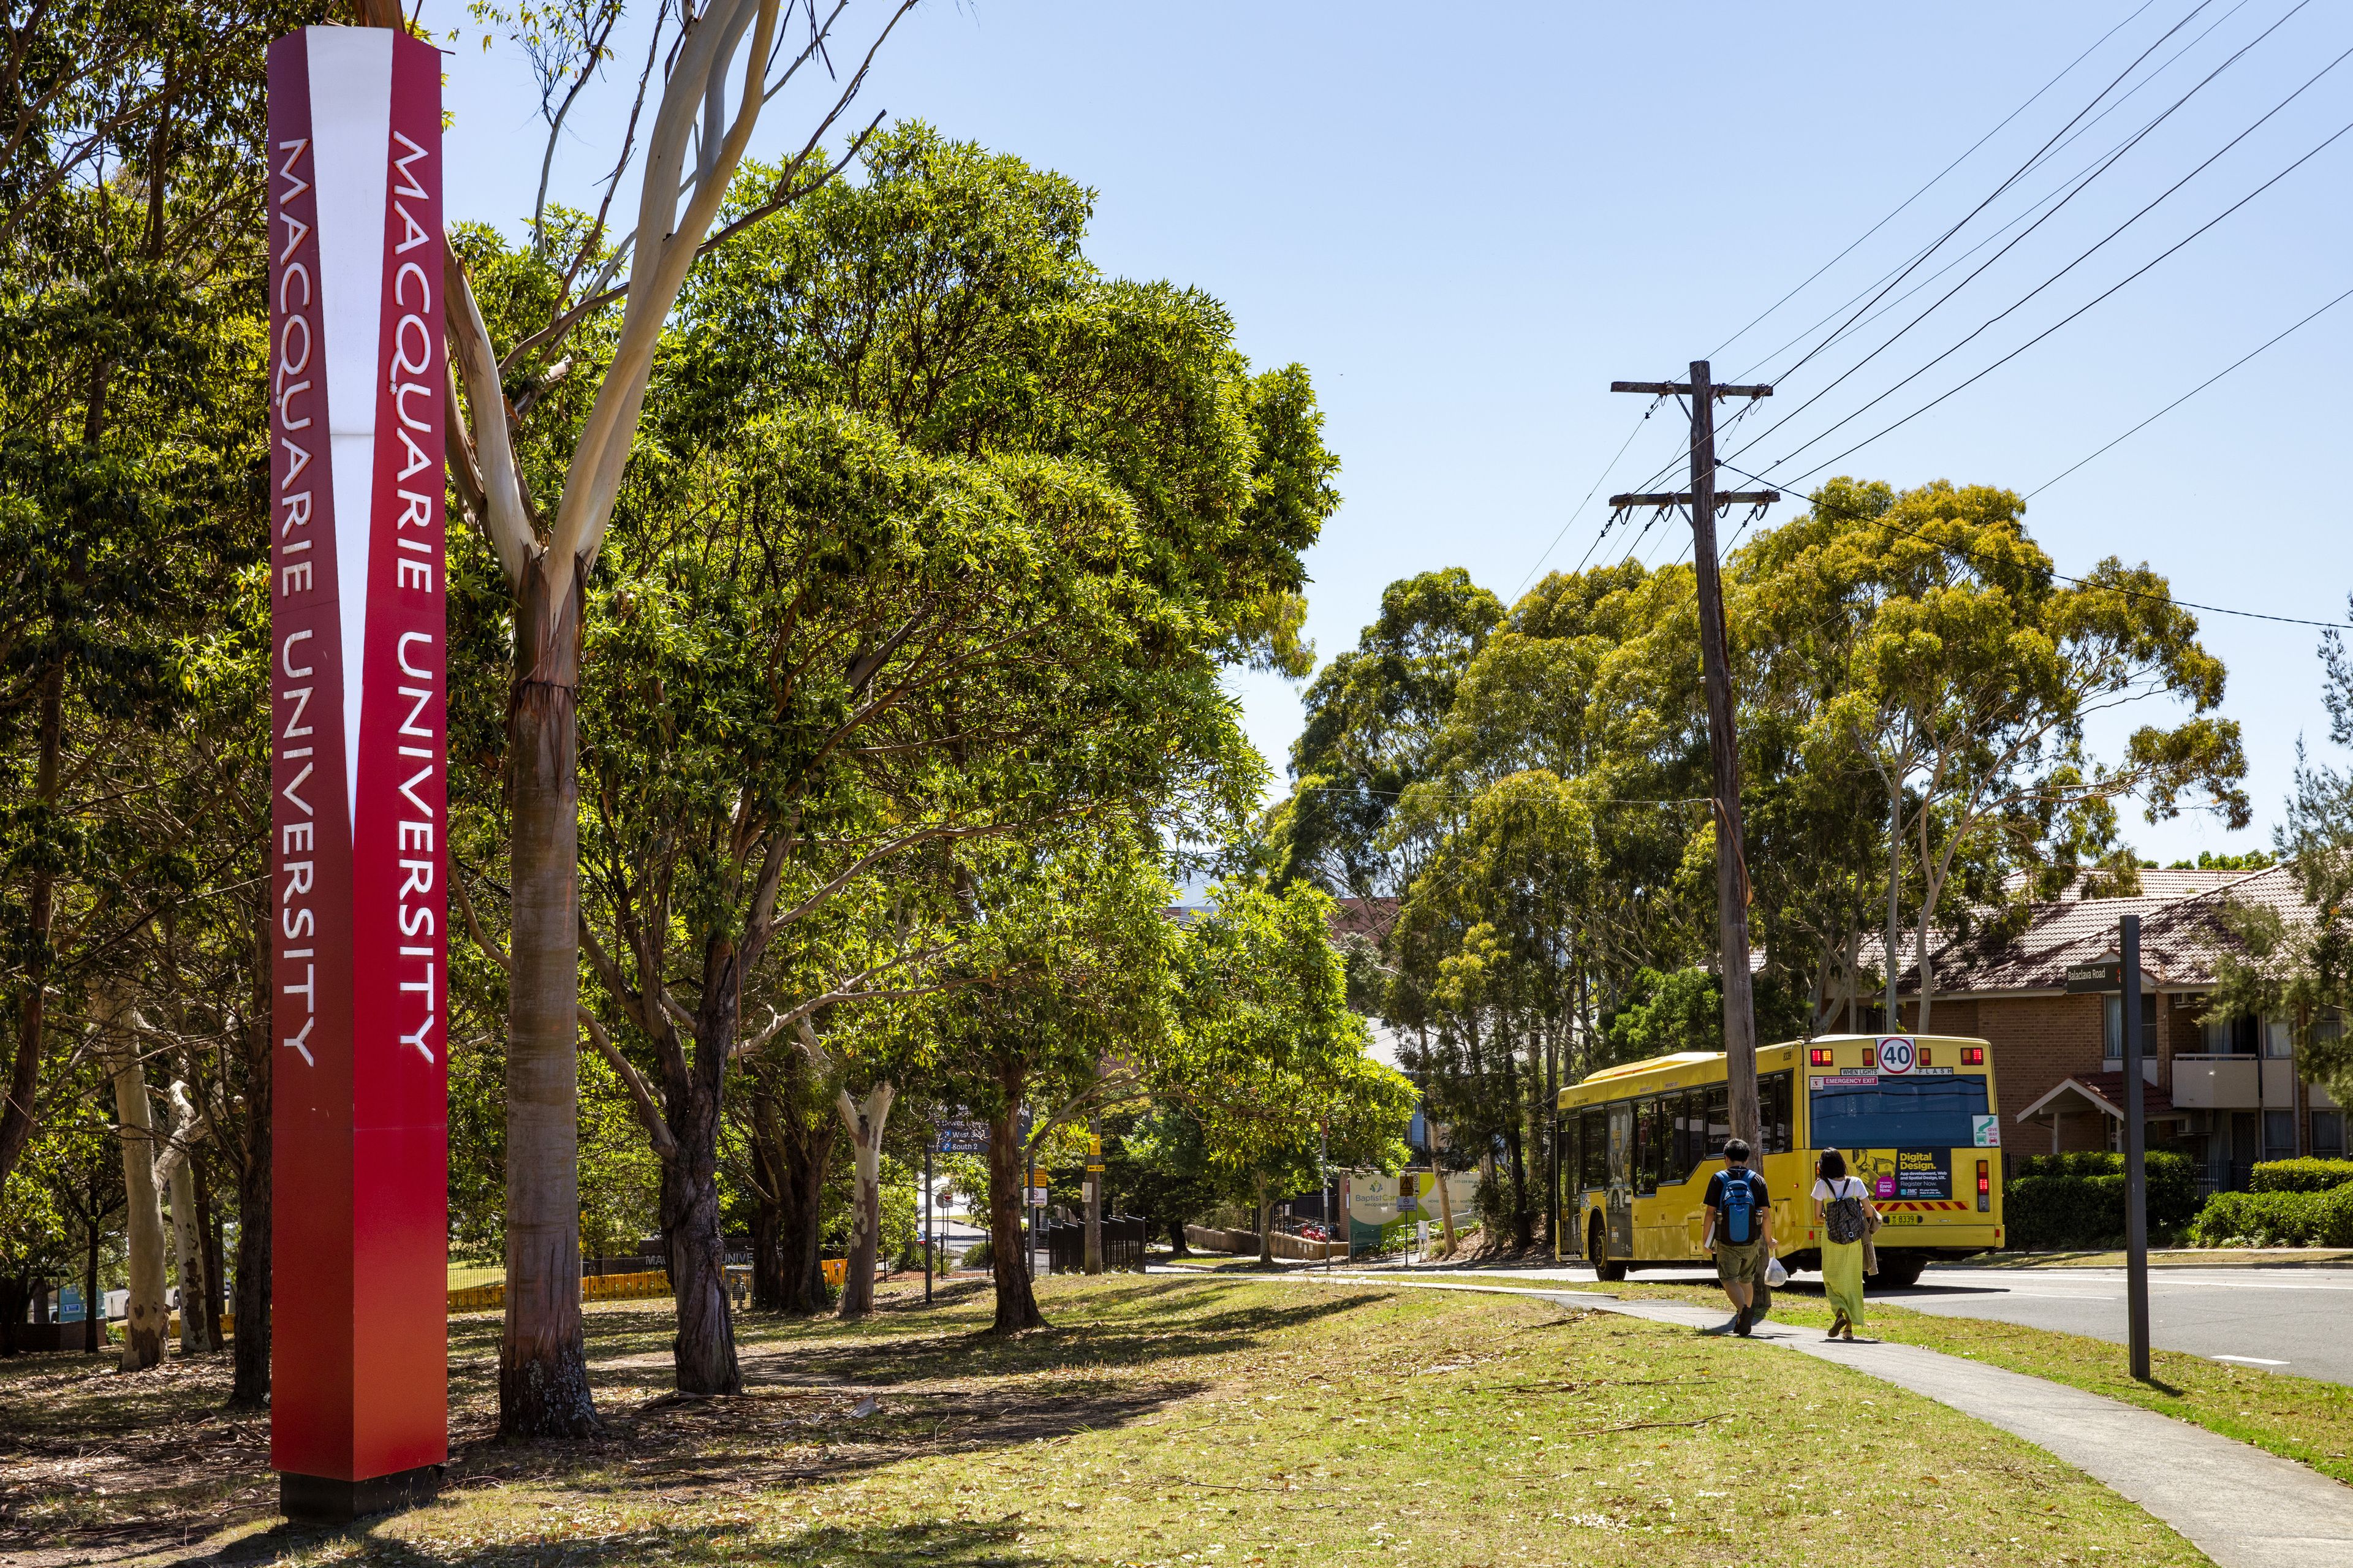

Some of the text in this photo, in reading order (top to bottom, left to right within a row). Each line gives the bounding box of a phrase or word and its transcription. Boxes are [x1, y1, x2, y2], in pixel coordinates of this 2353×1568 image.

[275, 138, 314, 1067] MACQUARIE UNIVERSITY
[388, 130, 434, 1064] MACQUARIE UNIVERSITY
[2068, 967, 2105, 980] Balaclava Road
[1884, 1046, 1910, 1064] 40
[1900, 1153, 1931, 1162] Digital
[1900, 1162, 1936, 1171] Design.
